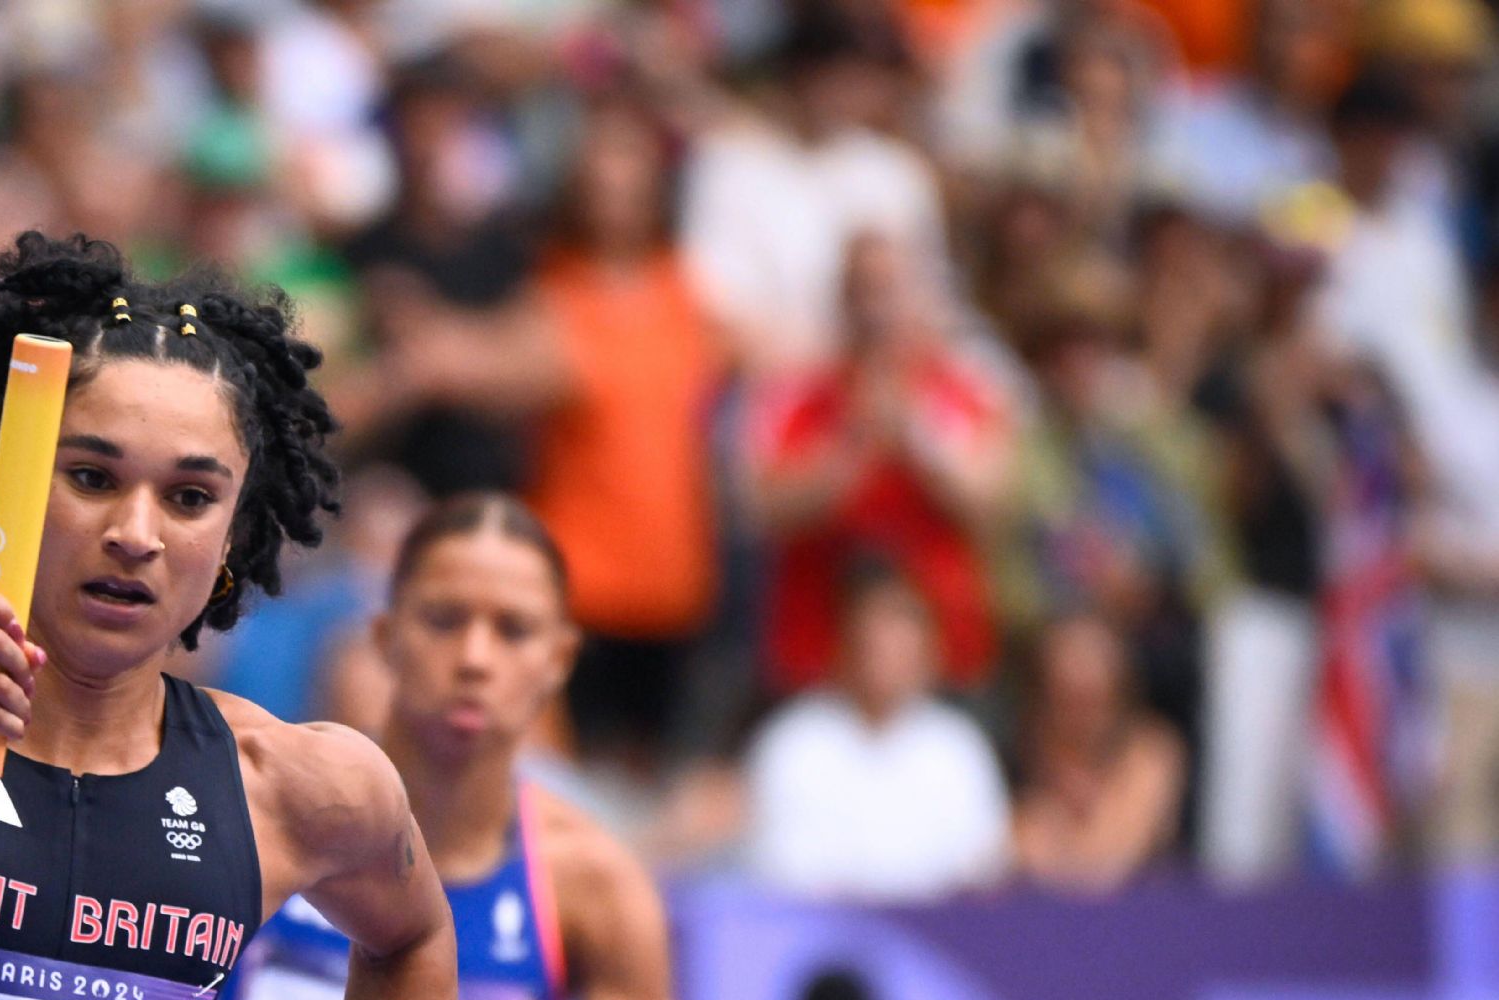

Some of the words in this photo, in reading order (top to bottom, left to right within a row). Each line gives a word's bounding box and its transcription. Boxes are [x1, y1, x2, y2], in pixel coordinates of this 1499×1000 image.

[161, 818, 188, 829] TEAM
[190, 821, 206, 832] GB
[70, 894, 244, 970] BRITAIN
